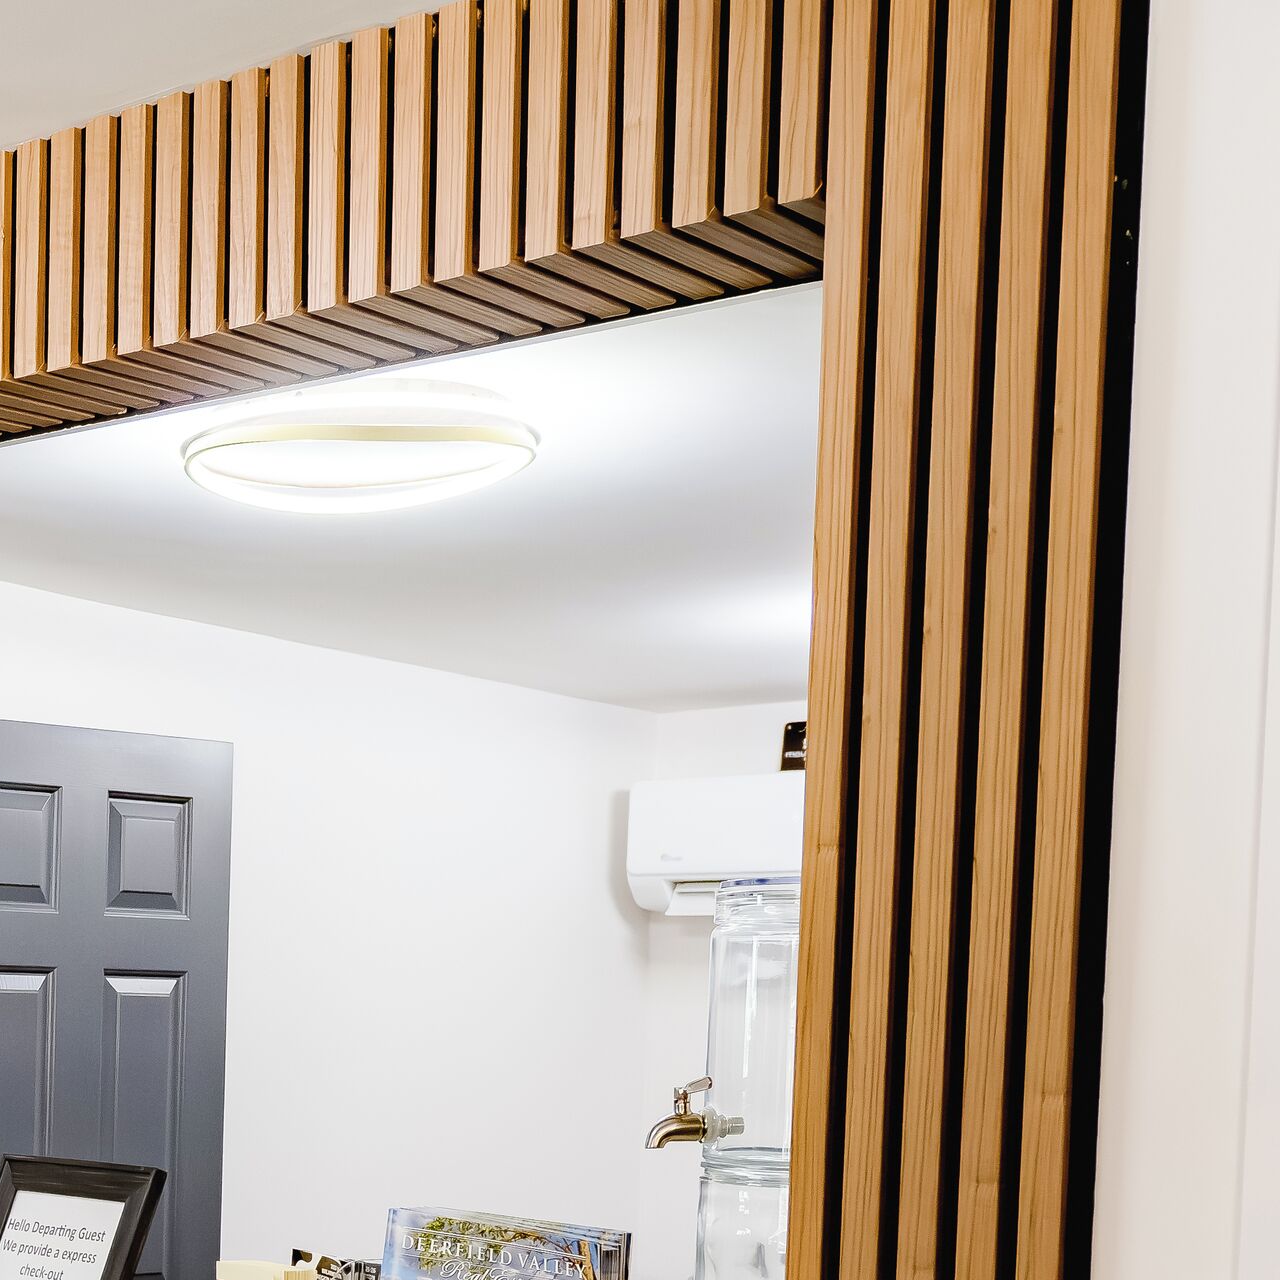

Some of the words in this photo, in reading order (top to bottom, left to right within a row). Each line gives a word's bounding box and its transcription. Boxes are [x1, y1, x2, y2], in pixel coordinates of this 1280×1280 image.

[7, 1218, 30, 1233] Hello
[32, 1221, 77, 1241] Departing
[78, 1226, 106, 1243] Guest
[3, 1239, 17, 1253] We
[18, 1243, 52, 1260] provide
[53, 1250, 60, 1259] a
[61, 1251, 97, 1265] express
[402, 1234, 513, 1268] DEERFIELD
[518, 1253, 587, 1279] VALLEY
